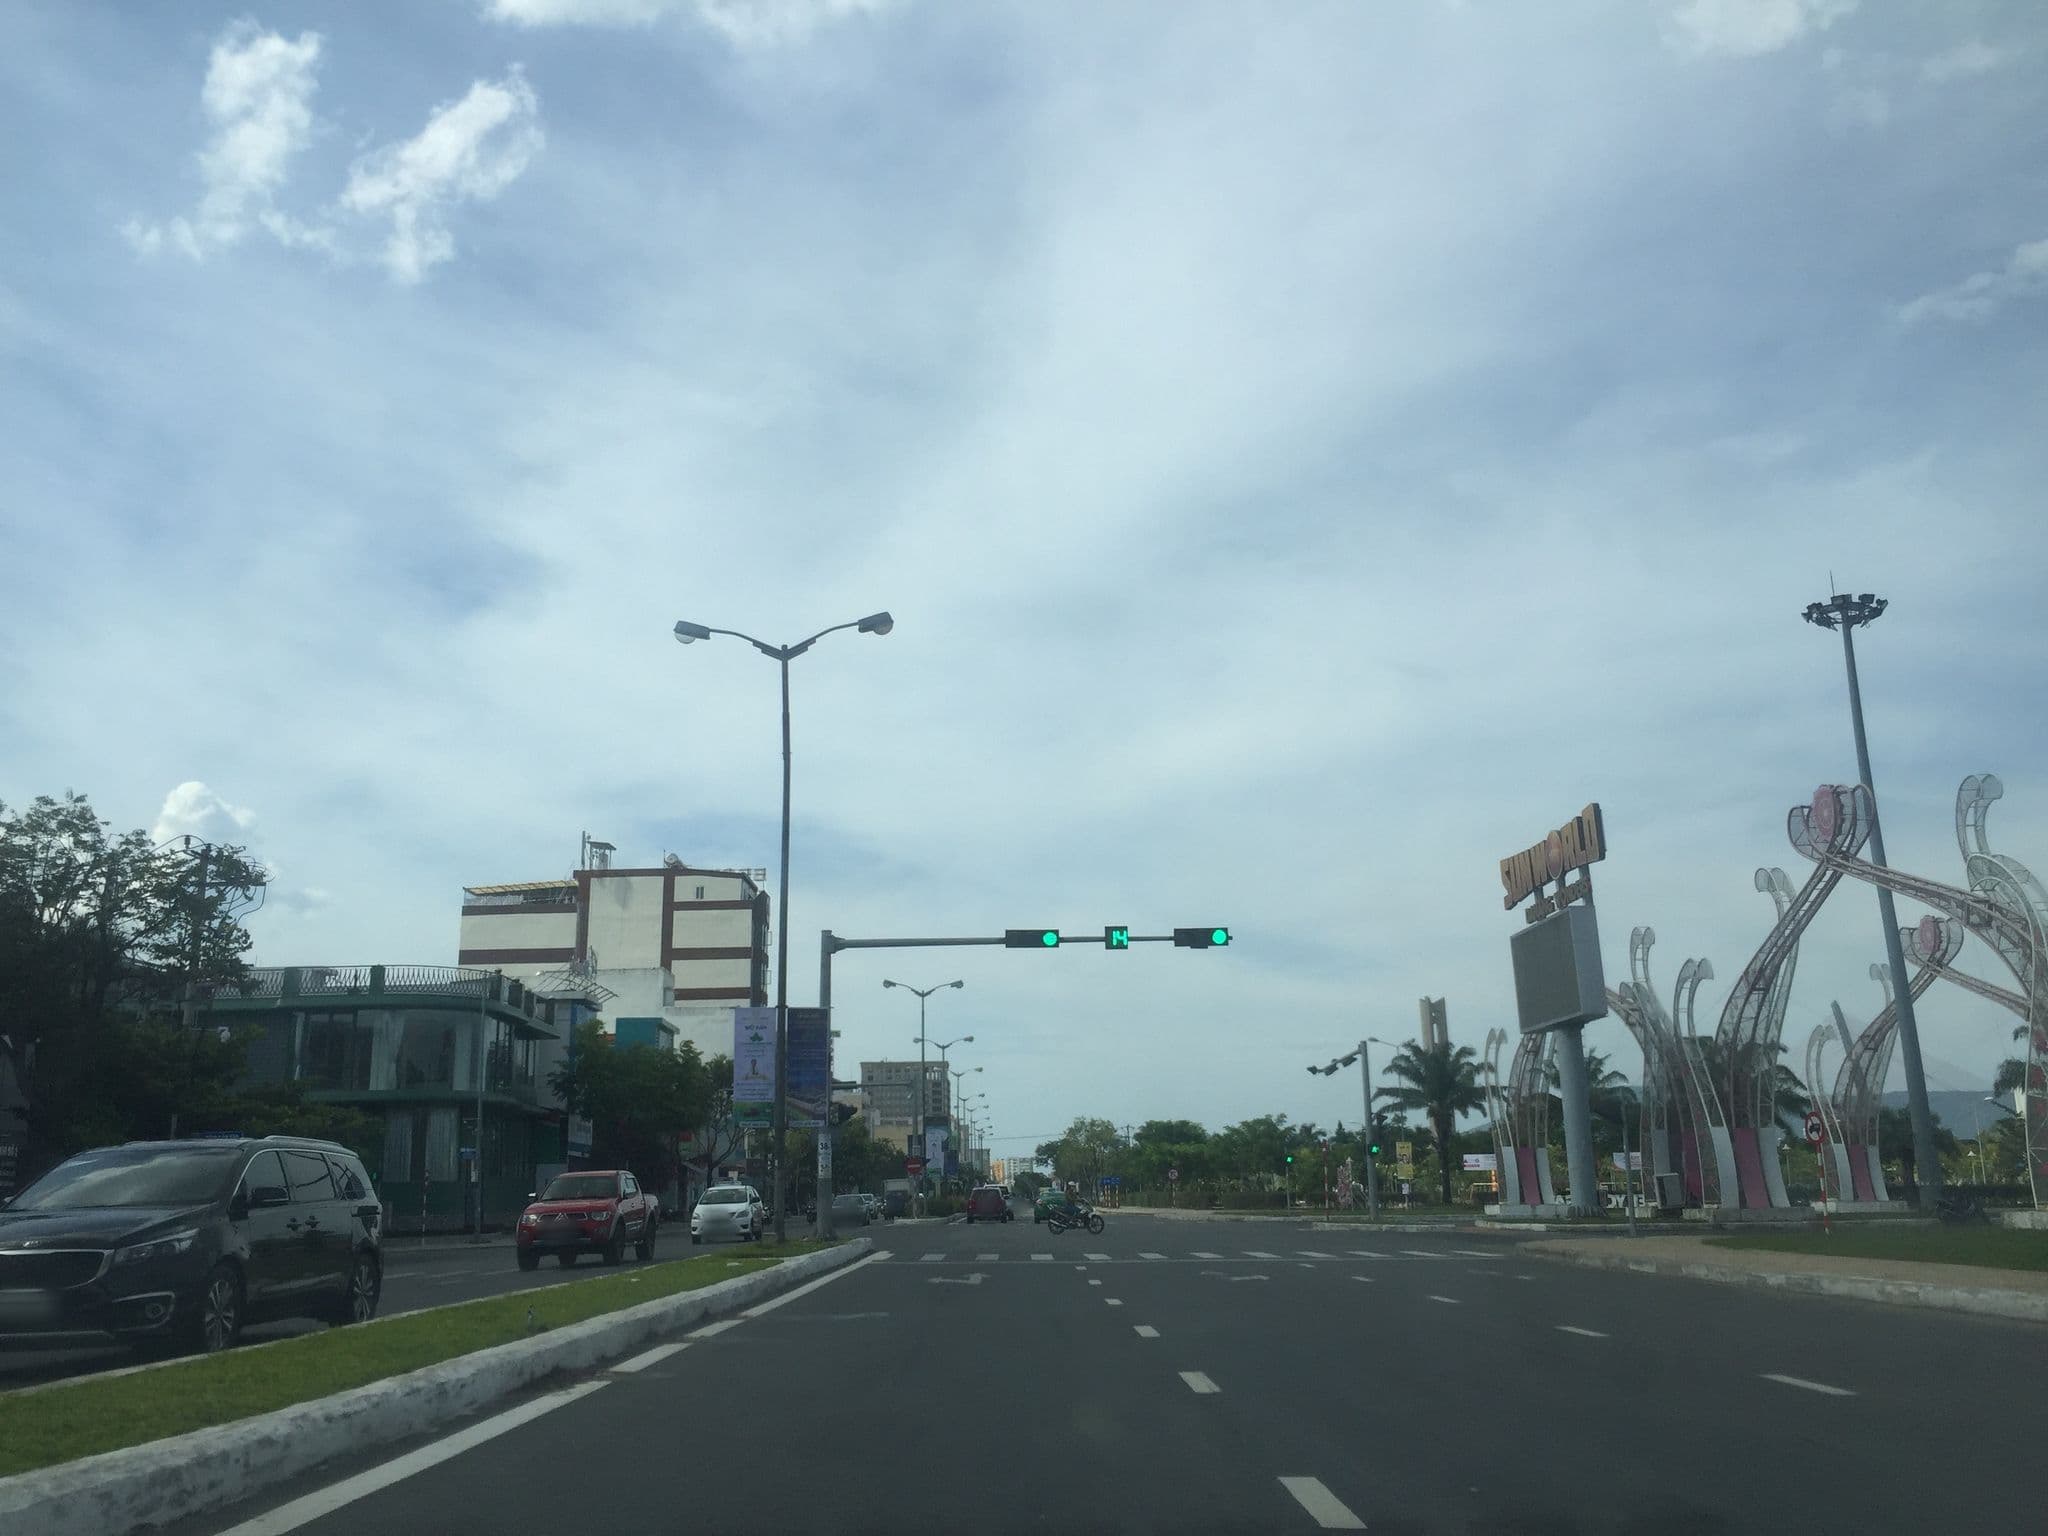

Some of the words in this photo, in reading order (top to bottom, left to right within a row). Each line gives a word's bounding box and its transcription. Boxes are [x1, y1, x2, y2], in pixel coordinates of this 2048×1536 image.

[1500, 850, 1534, 910] SUN
[1531, 803, 1603, 888] WORLD
[1112, 930, 1128, 946] 14
